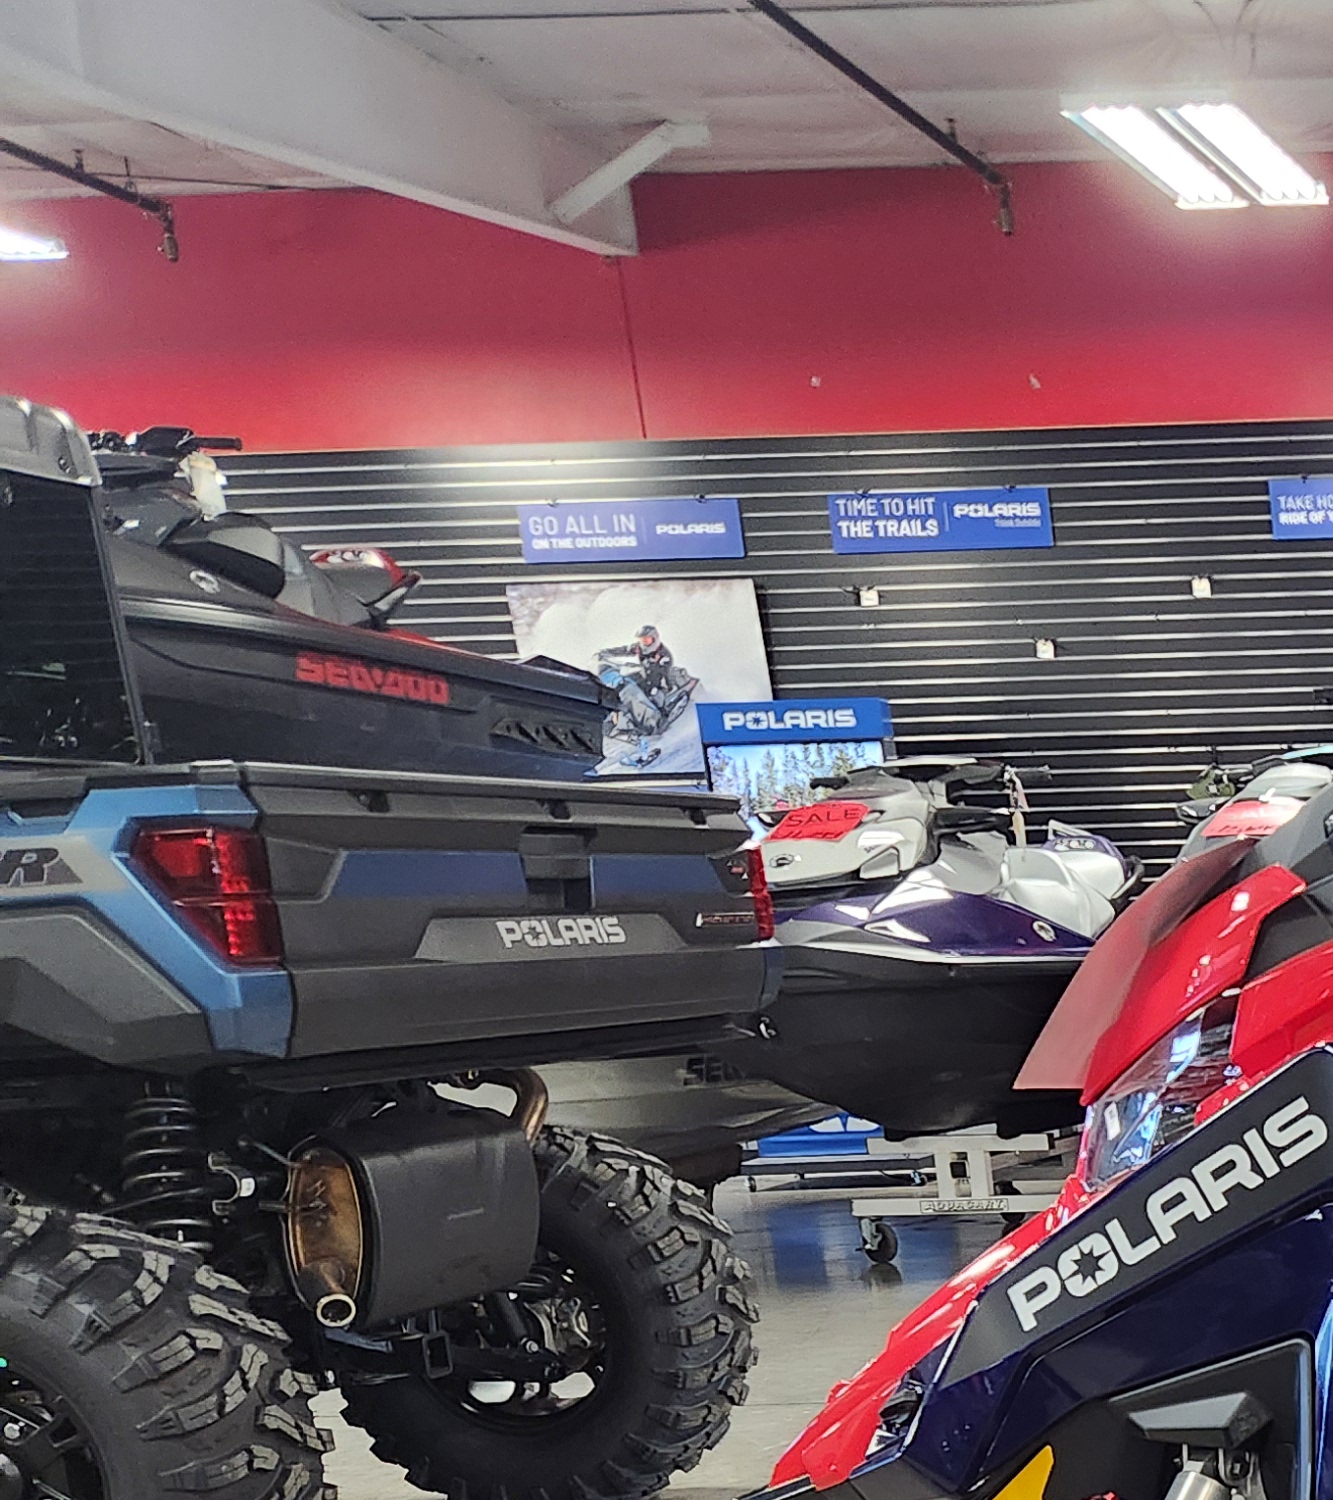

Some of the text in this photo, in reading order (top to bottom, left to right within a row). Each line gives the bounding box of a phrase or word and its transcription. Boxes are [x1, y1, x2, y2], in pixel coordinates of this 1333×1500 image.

[835, 496, 936, 517] TIME TO HIT
[952, 501, 1042, 519] POLARIS
[1278, 494, 1314, 511] TAKE
[528, 512, 637, 535] GO ALL IN
[1279, 510, 1308, 525] RIDE
[1309, 510, 1326, 525] OF
[655, 521, 727, 536] POLARIS
[837, 518, 940, 538] THE TRAILS
[532, 535, 638, 549] ON THE OUTDOORS
[722, 708, 858, 731] POLARIS
[786, 806, 863, 829] SALE
[495, 915, 626, 949] POLARIS
[1006, 1095, 1328, 1332] POLARIS
